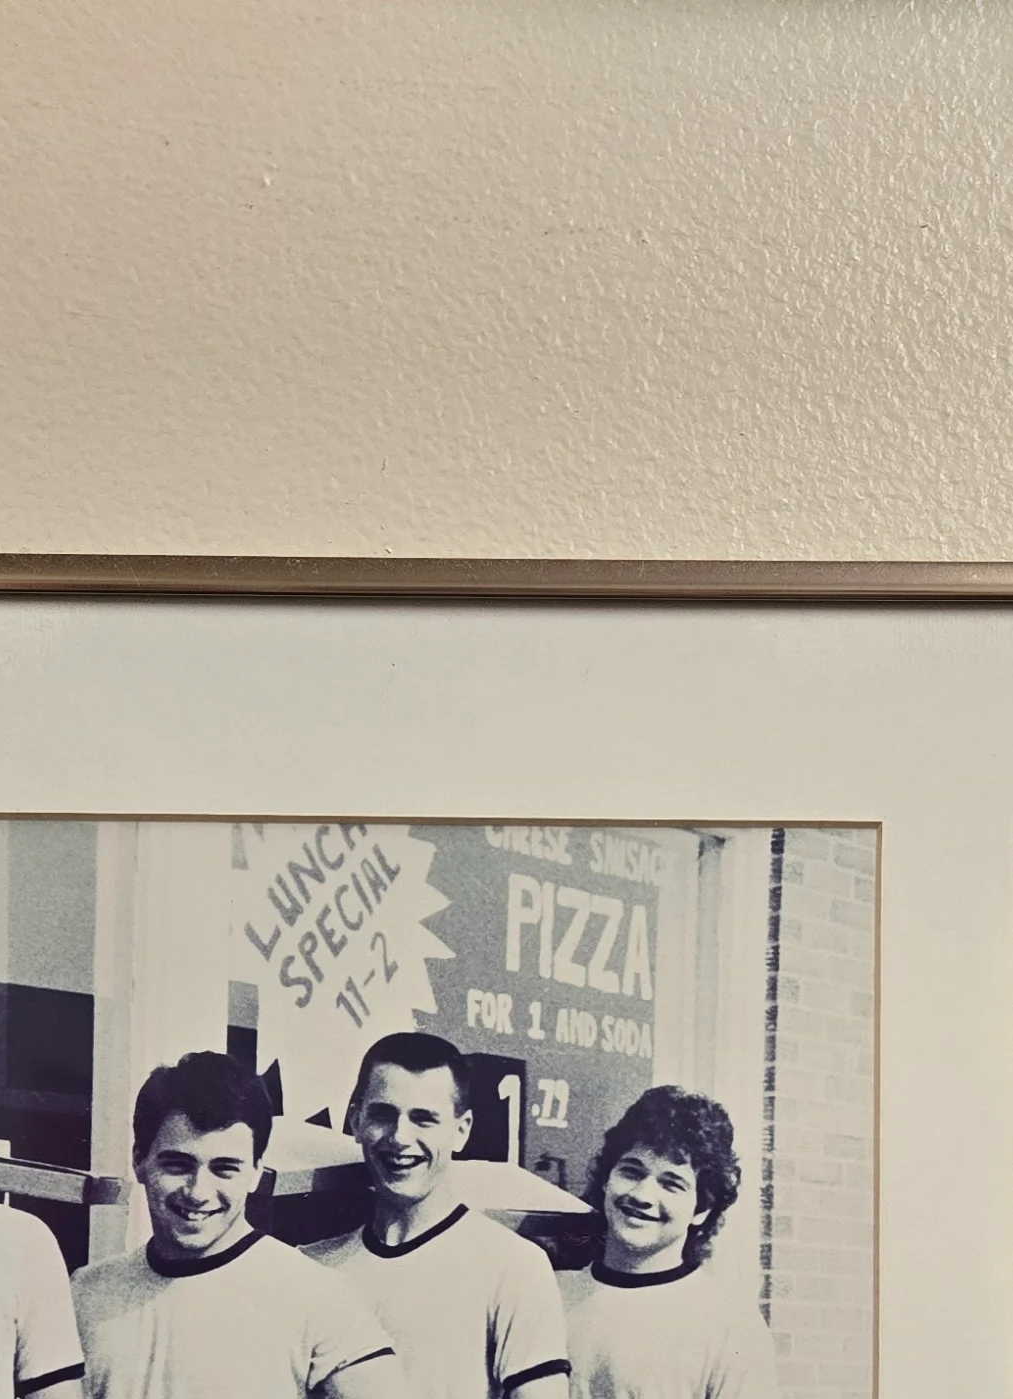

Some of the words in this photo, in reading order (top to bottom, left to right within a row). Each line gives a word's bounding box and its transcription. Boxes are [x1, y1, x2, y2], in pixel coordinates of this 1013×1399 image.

[279, 844, 401, 1009] SPECIAL
[505, 872, 654, 1001] PIZZA
[466, 988, 514, 1036] FOR
[527, 1000, 546, 1040] 1
[555, 1007, 598, 1049] AND
[601, 1016, 653, 1058] SODA
